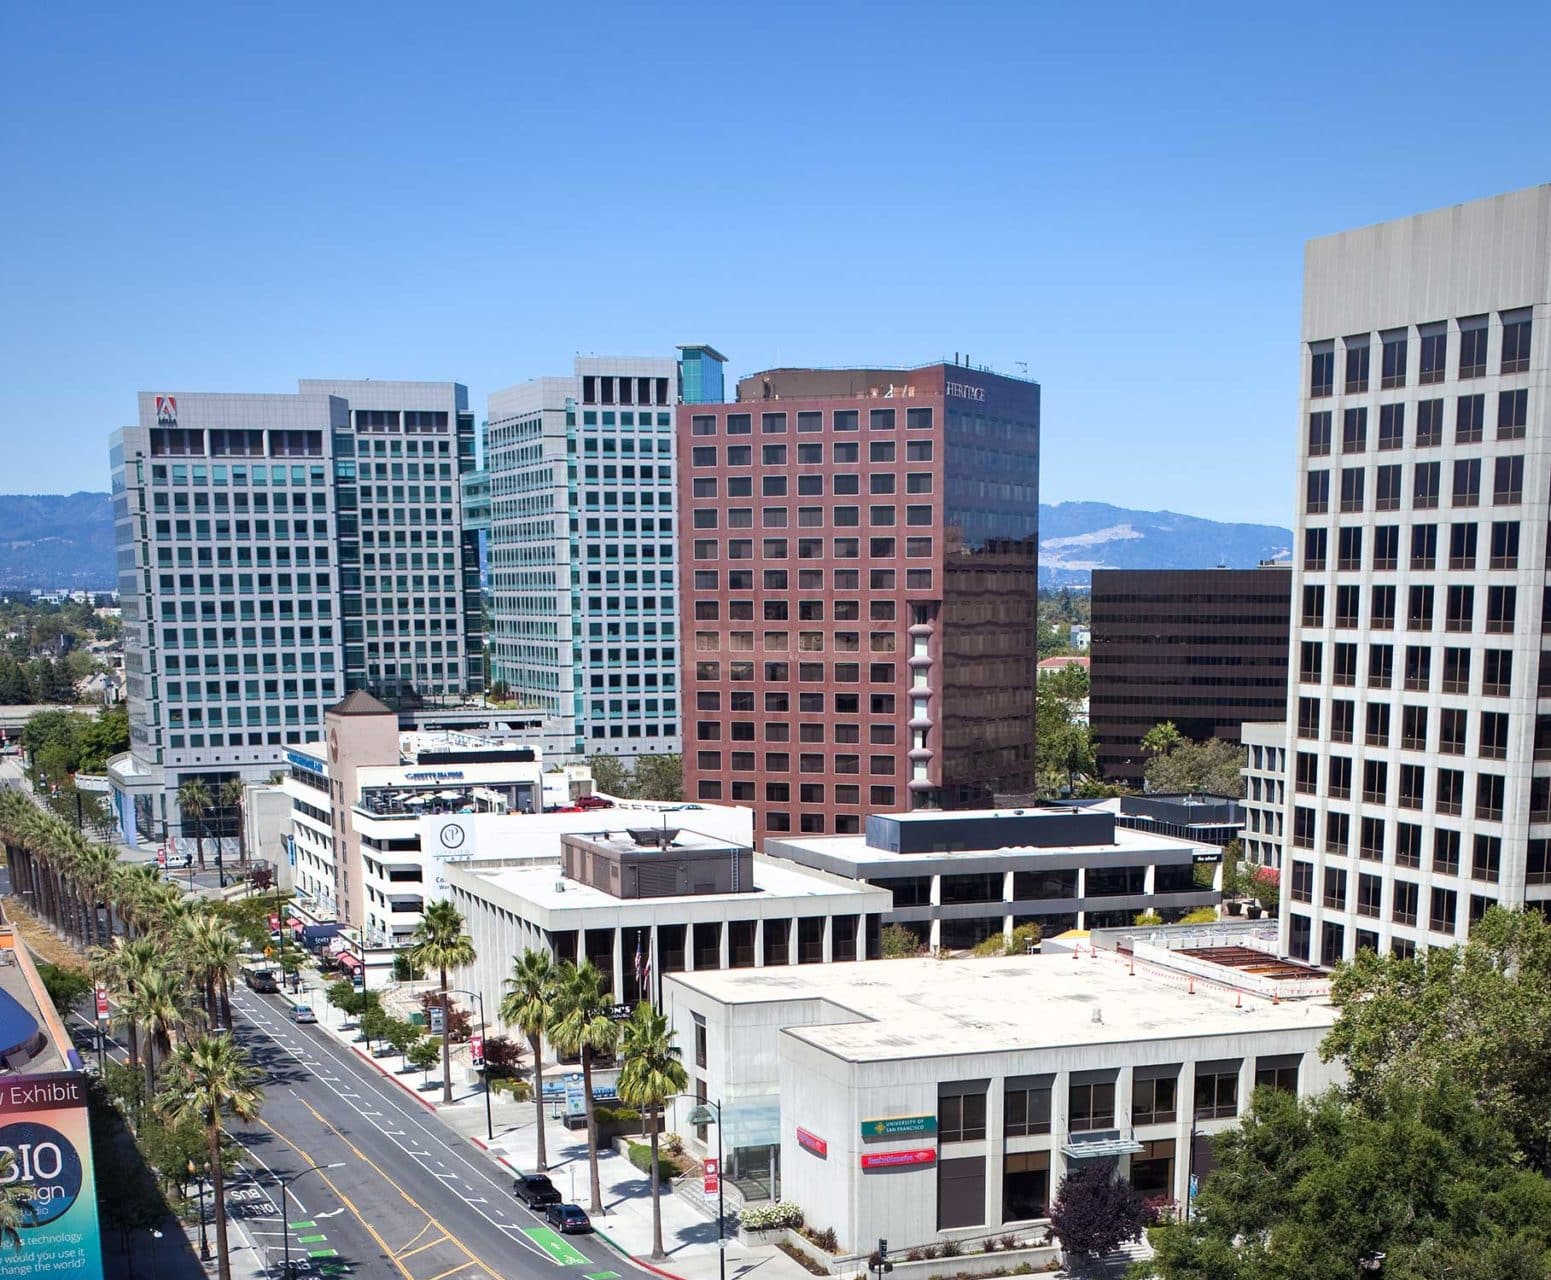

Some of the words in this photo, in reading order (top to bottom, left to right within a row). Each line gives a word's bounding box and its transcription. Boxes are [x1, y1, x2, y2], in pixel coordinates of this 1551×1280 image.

[946, 381, 986, 402] HERITAGE
[10, 1082, 79, 1104] Exhibit
[231, 1189, 262, 1200] BUS
[28, 1232, 83, 1246] technology.
[4, 1252, 34, 1263] would
[36, 1252, 55, 1263] you
[58, 1250, 76, 1258] use
[78, 1248, 85, 1257] it
[35, 1262, 51, 1272] the
[53, 1258, 86, 1270] world?
